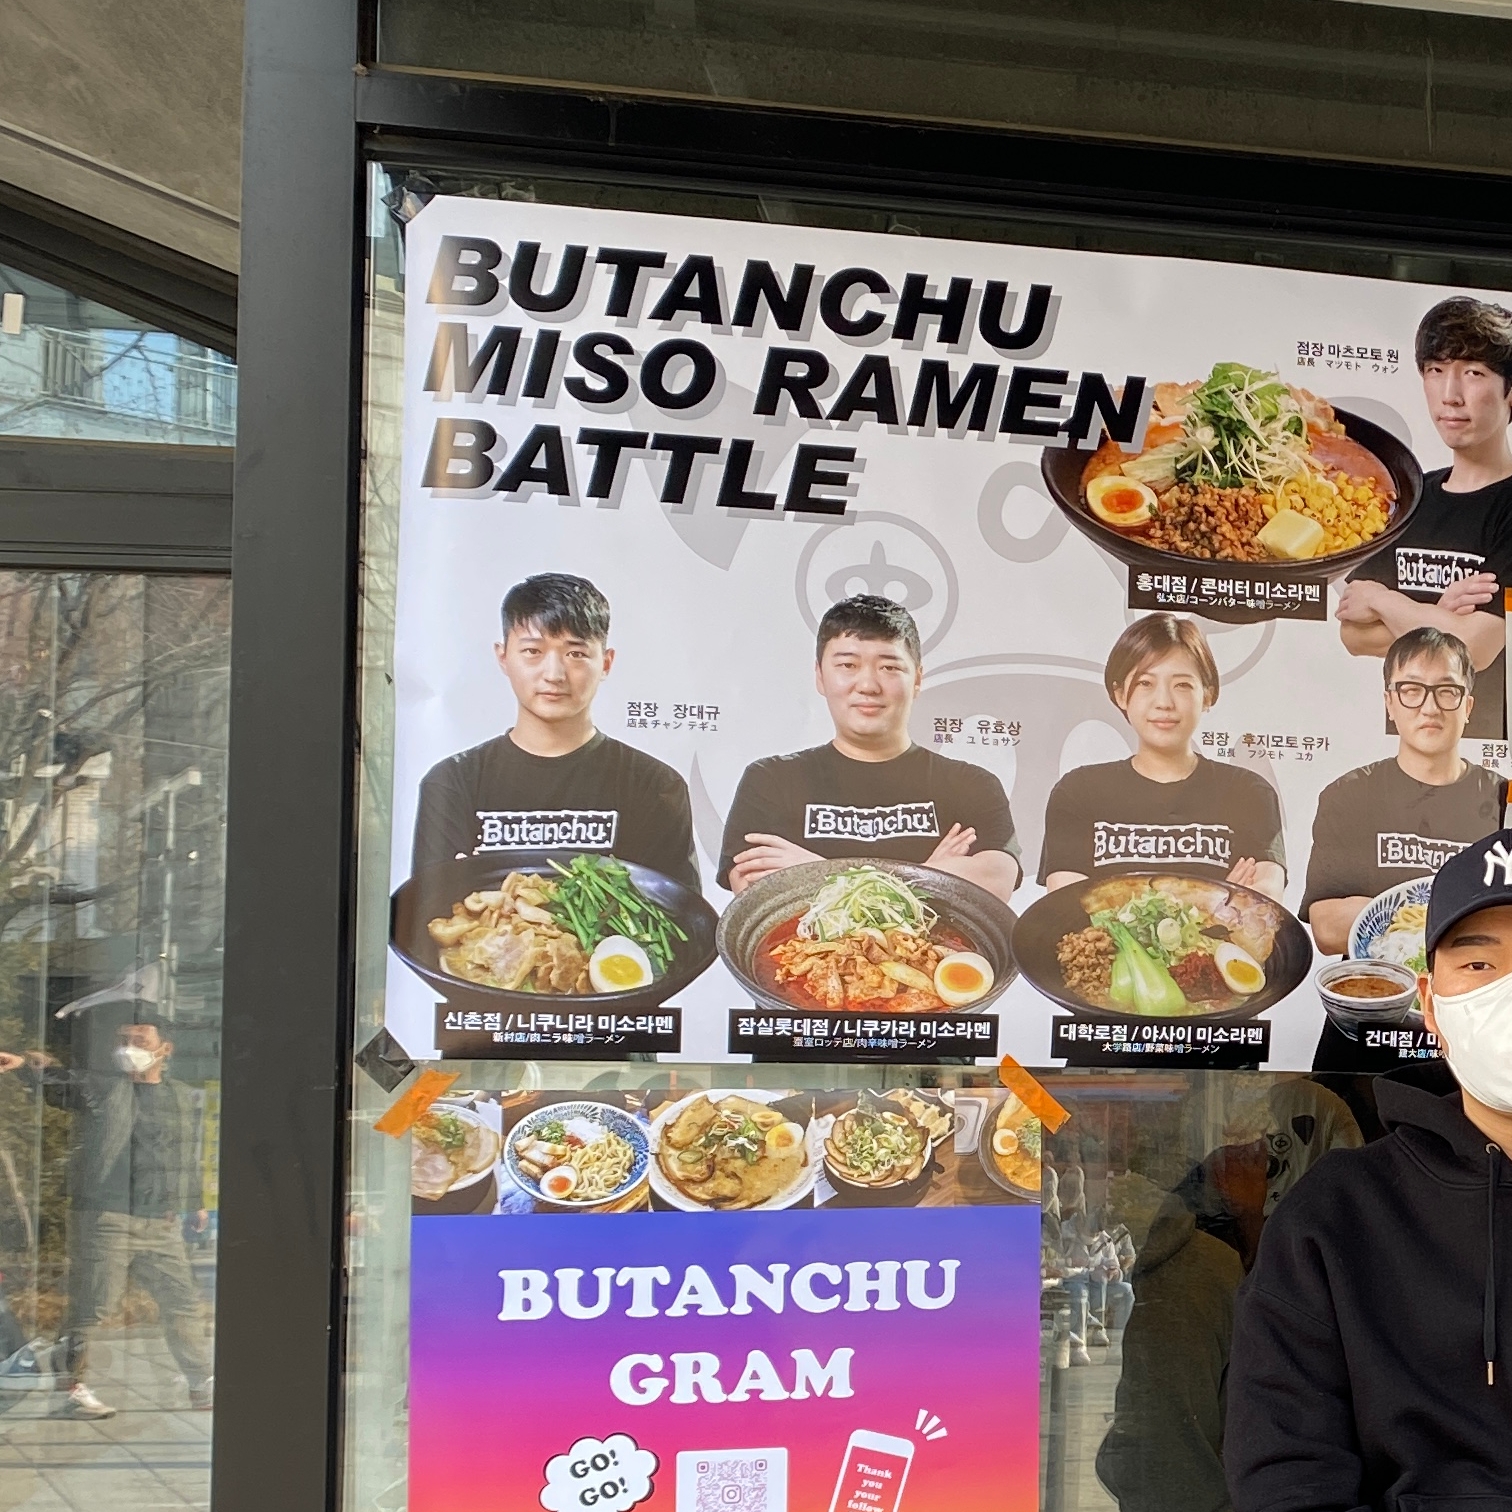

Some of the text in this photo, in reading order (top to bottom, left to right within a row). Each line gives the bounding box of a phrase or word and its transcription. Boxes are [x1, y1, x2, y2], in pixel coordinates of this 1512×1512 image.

[425, 234, 1053, 350] BUTANCHU
[1297, 341, 1399, 363] 점장 마츠모토 원
[423, 321, 1147, 443] MISO RAMEN
[420, 417, 857, 516] BATTLE
[1136, 573, 1187, 593] 홍대점
[1201, 577, 1250, 598] 콘버터
[1254, 581, 1320, 602] 미소라멘
[627, 702, 720, 720] 점장 장대규
[933, 718, 1021, 736] 점장 유효상
[1202, 732, 1330, 751] 점장 후지모토 유카
[1482, 744, 1508, 758] 점장
[483, 818, 607, 843] Butanchu
[816, 810, 931, 835] Butanchu
[1094, 829, 1231, 859] Butanchu
[444, 1012, 501, 1031] 신촌점
[517, 1014, 594, 1031] 니쿠니라
[599, 1015, 674, 1034] 미소라멘
[737, 1017, 829, 1036] 잠실롯데점
[844, 1020, 915, 1038] 니쿠카라
[920, 1021, 992, 1040] 미소라멘
[1060, 1024, 1128, 1041] 대학로점
[1142, 1025, 1191, 1043] 야사이
[1197, 1027, 1263, 1045] 미소라멘
[1365, 1030, 1414, 1047] 건대점
[499, 1259, 961, 1321] BUTANCHU
[610, 1347, 855, 1406] GRAM
[570, 1450, 619, 1478] GO!
[857, 1463, 892, 1479] Thank
[579, 1477, 628, 1507] GO!
[854, 1490, 881, 1502] your
[861, 1480, 882, 1490] you
